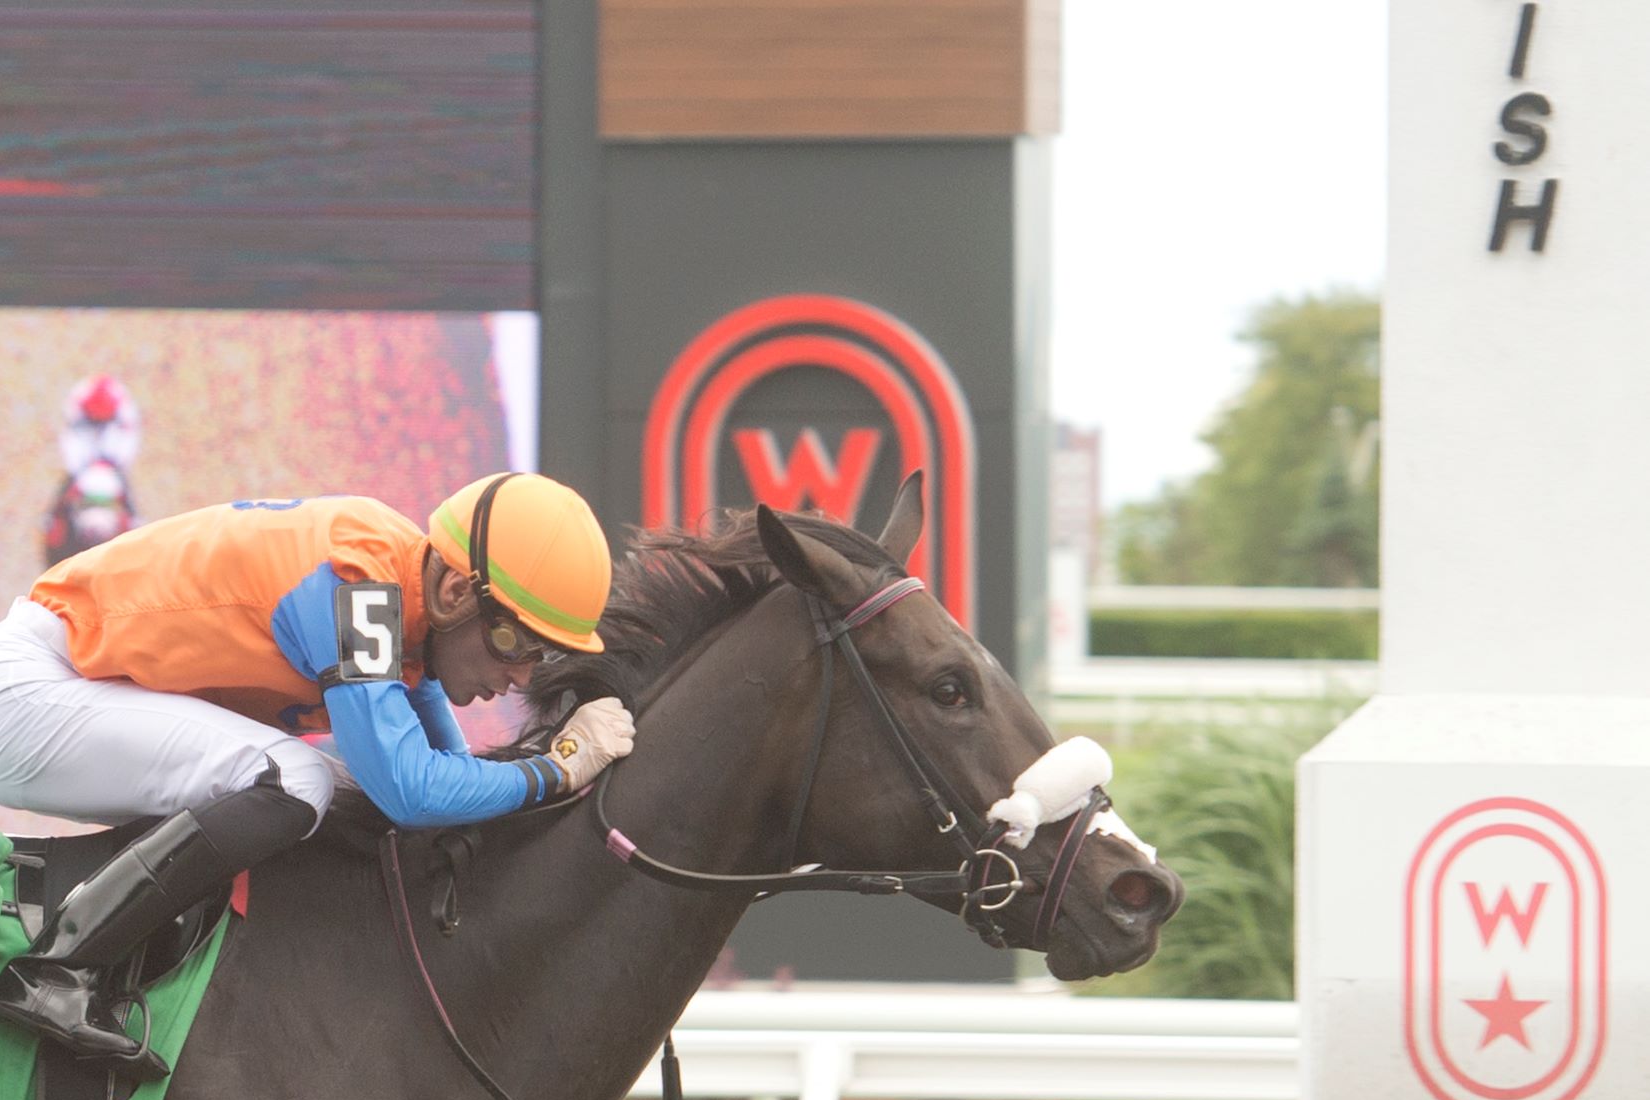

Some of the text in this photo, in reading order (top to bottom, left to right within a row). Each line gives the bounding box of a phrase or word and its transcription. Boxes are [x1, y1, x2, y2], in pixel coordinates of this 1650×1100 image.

[733, 426, 881, 526] W
[351, 590, 393, 675] 5
[1462, 882, 1550, 949] W
